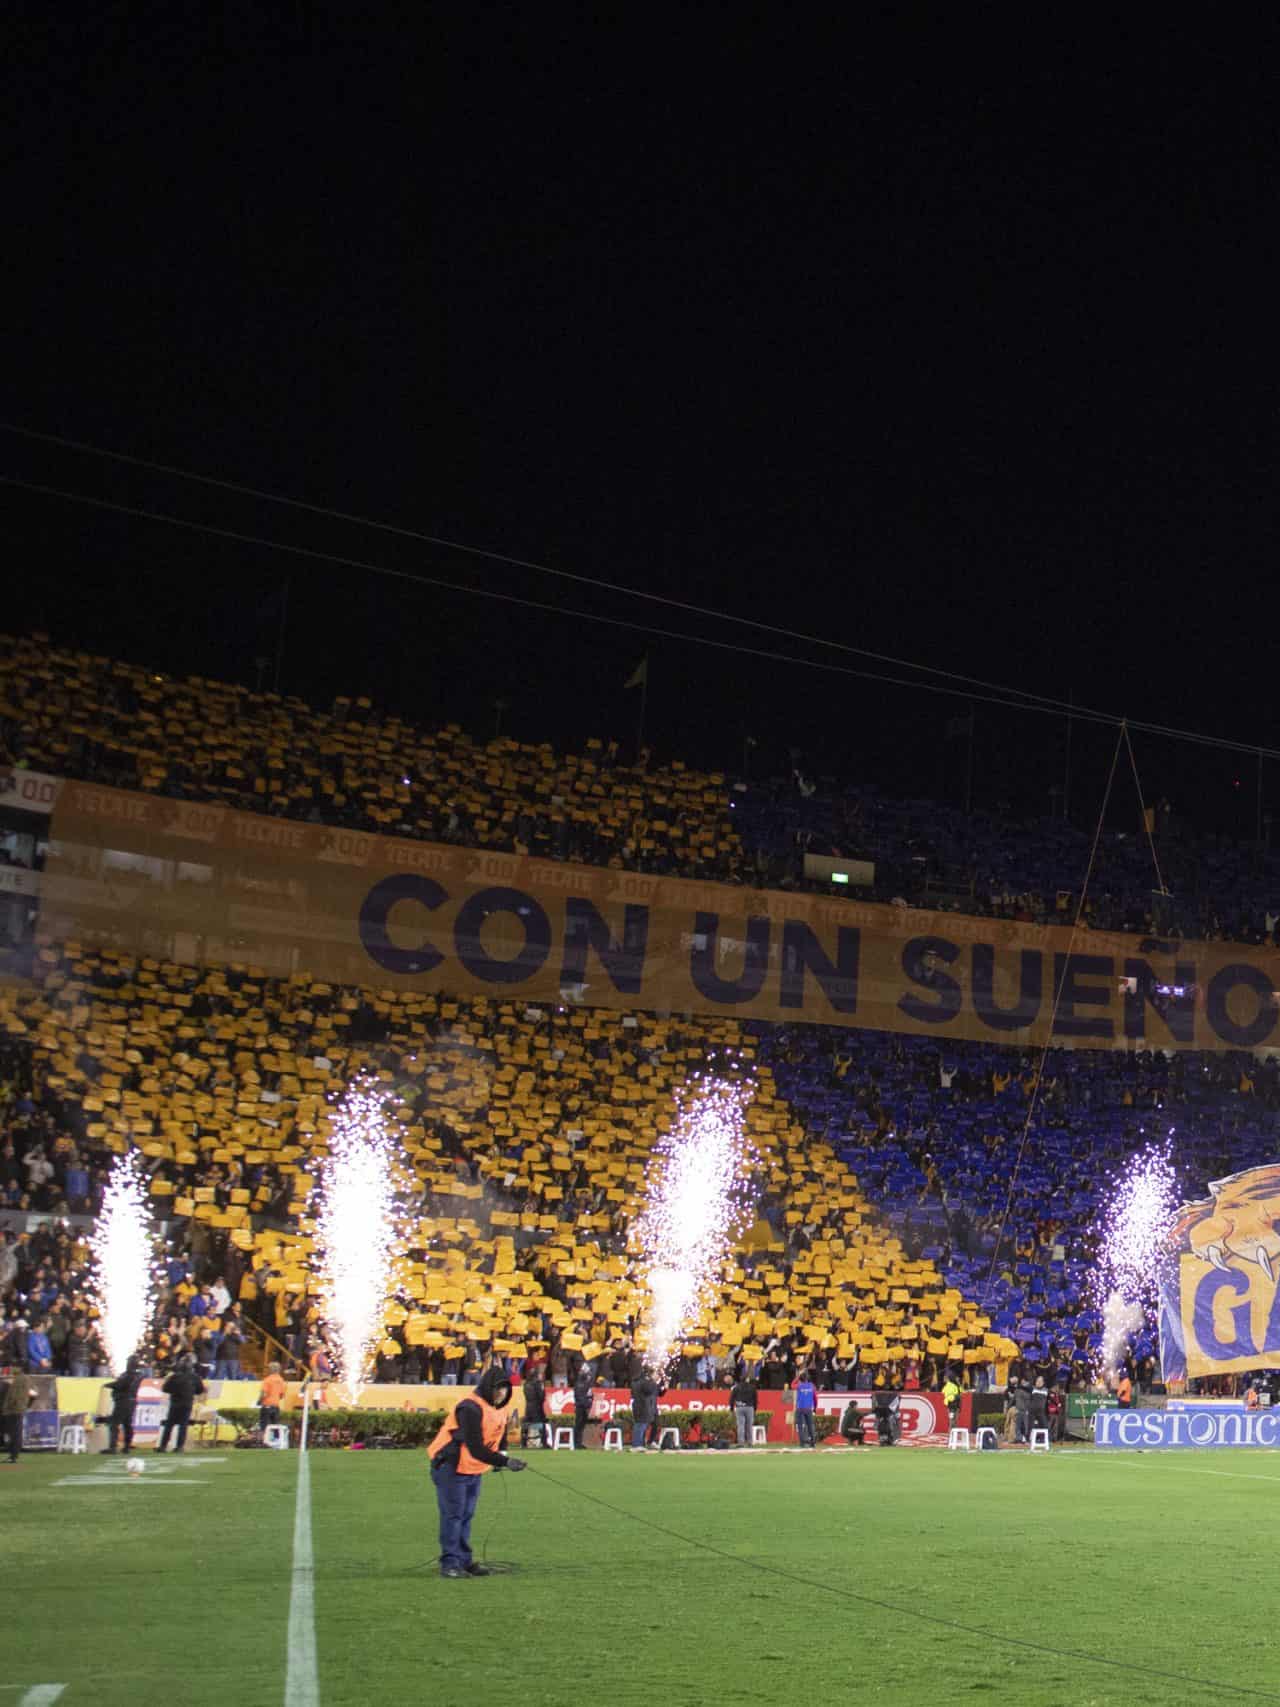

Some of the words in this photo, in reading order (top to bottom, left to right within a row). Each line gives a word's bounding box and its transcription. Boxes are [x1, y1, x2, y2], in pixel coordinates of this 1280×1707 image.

[358, 872, 649, 994] CON
[690, 910, 860, 1014] UN
[898, 935, 1280, 1047] SUEÑO
